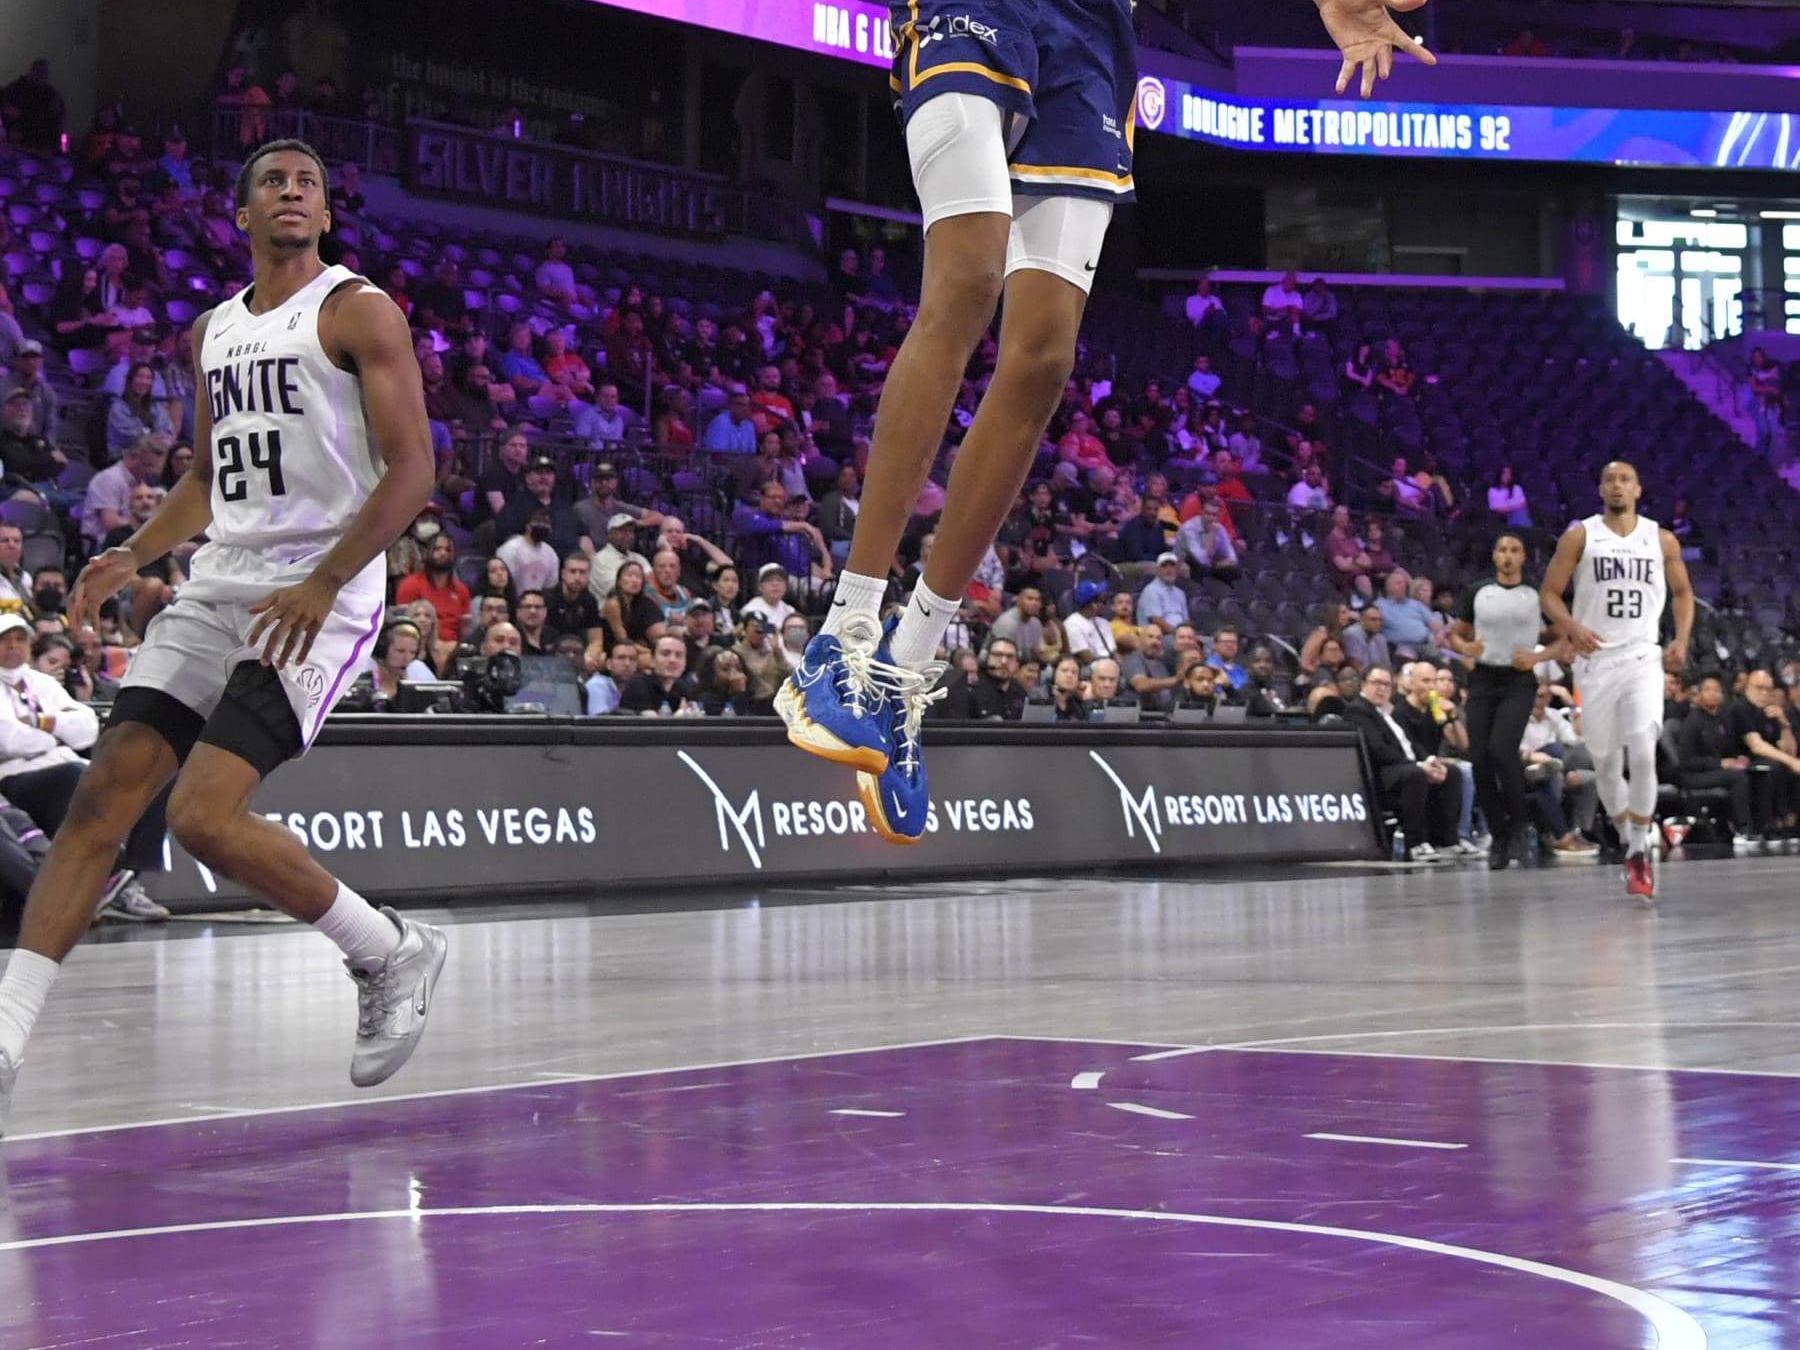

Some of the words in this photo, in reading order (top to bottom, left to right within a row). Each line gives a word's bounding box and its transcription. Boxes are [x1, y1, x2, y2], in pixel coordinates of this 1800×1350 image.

[813, 3, 850, 49] NBA
[856, 13, 868, 53] G
[946, 14, 998, 43] idex
[1182, 94, 1265, 142] BOULOGNE
[1273, 109, 1472, 150] METROPOLITANS
[1480, 116, 1511, 150] 92
[418, 135, 553, 206] SILVER
[218, 430, 286, 502] 24
[1593, 557, 1655, 585] IGNITE
[1607, 589, 1642, 618] 23
[401, 809, 467, 848] LAS
[477, 806, 597, 845] VEGAS
[772, 800, 877, 836] RESOR
[944, 798, 1034, 832] VEGAS
[1164, 795, 1247, 825] RESORT
[1253, 794, 1293, 823] LAS
[1295, 792, 1367, 822] VEGAS
